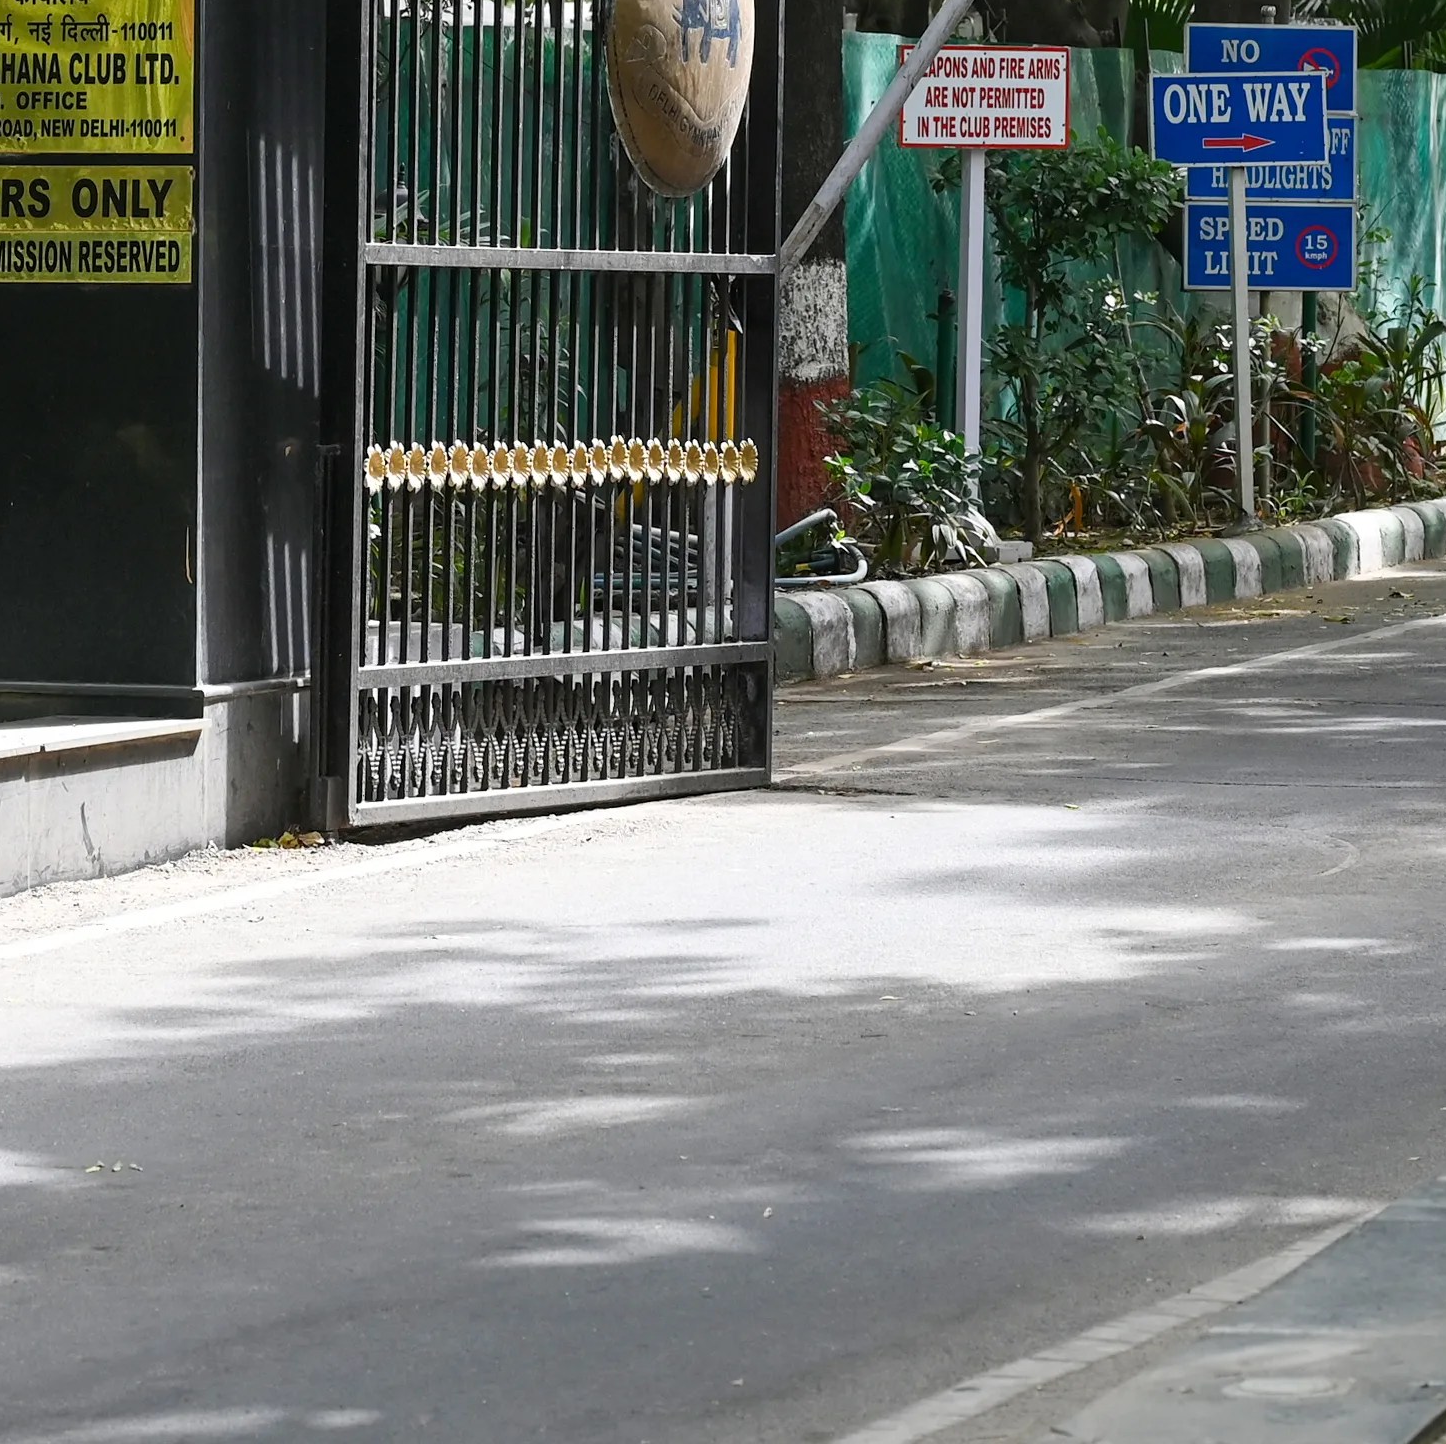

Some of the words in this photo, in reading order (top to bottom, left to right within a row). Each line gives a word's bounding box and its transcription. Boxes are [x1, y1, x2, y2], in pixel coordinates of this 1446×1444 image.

[27, 14, 53, 44] नई
[1221, 39, 1261, 64] NO
[69, 52, 127, 85] CLUB
[135, 53, 180, 86] LTD.
[922, 57, 968, 79] APONS
[971, 57, 996, 79] AND
[999, 58, 1025, 79] FIRE
[1028, 58, 1060, 80] ARMS
[16, 91, 88, 110] OFFICE
[925, 86, 949, 108] ARE
[952, 87, 976, 108] NOT
[979, 87, 1045, 109] PERMITTED
[1163, 83, 1232, 125] ONE
[1243, 82, 1311, 123] WAY
[41, 119, 75, 138] NEW
[80, 119, 177, 138] DELHI-110011
[917, 116, 930, 138] IN
[933, 116, 957, 138] THE
[959, 116, 990, 138] CLUB
[993, 116, 1052, 138] PREMISES
[1328, 128, 1351, 155] FF
[1211, 164, 1333, 190] HDLIGHTS
[71, 178, 173, 218] ONLY
[1200, 217, 1285, 241] SPED
[1305, 234, 1328, 250] 15
[78, 240, 180, 273] RESERVED
[1205, 250, 1279, 275] LIIT
[1305, 252, 1328, 261] kmph
